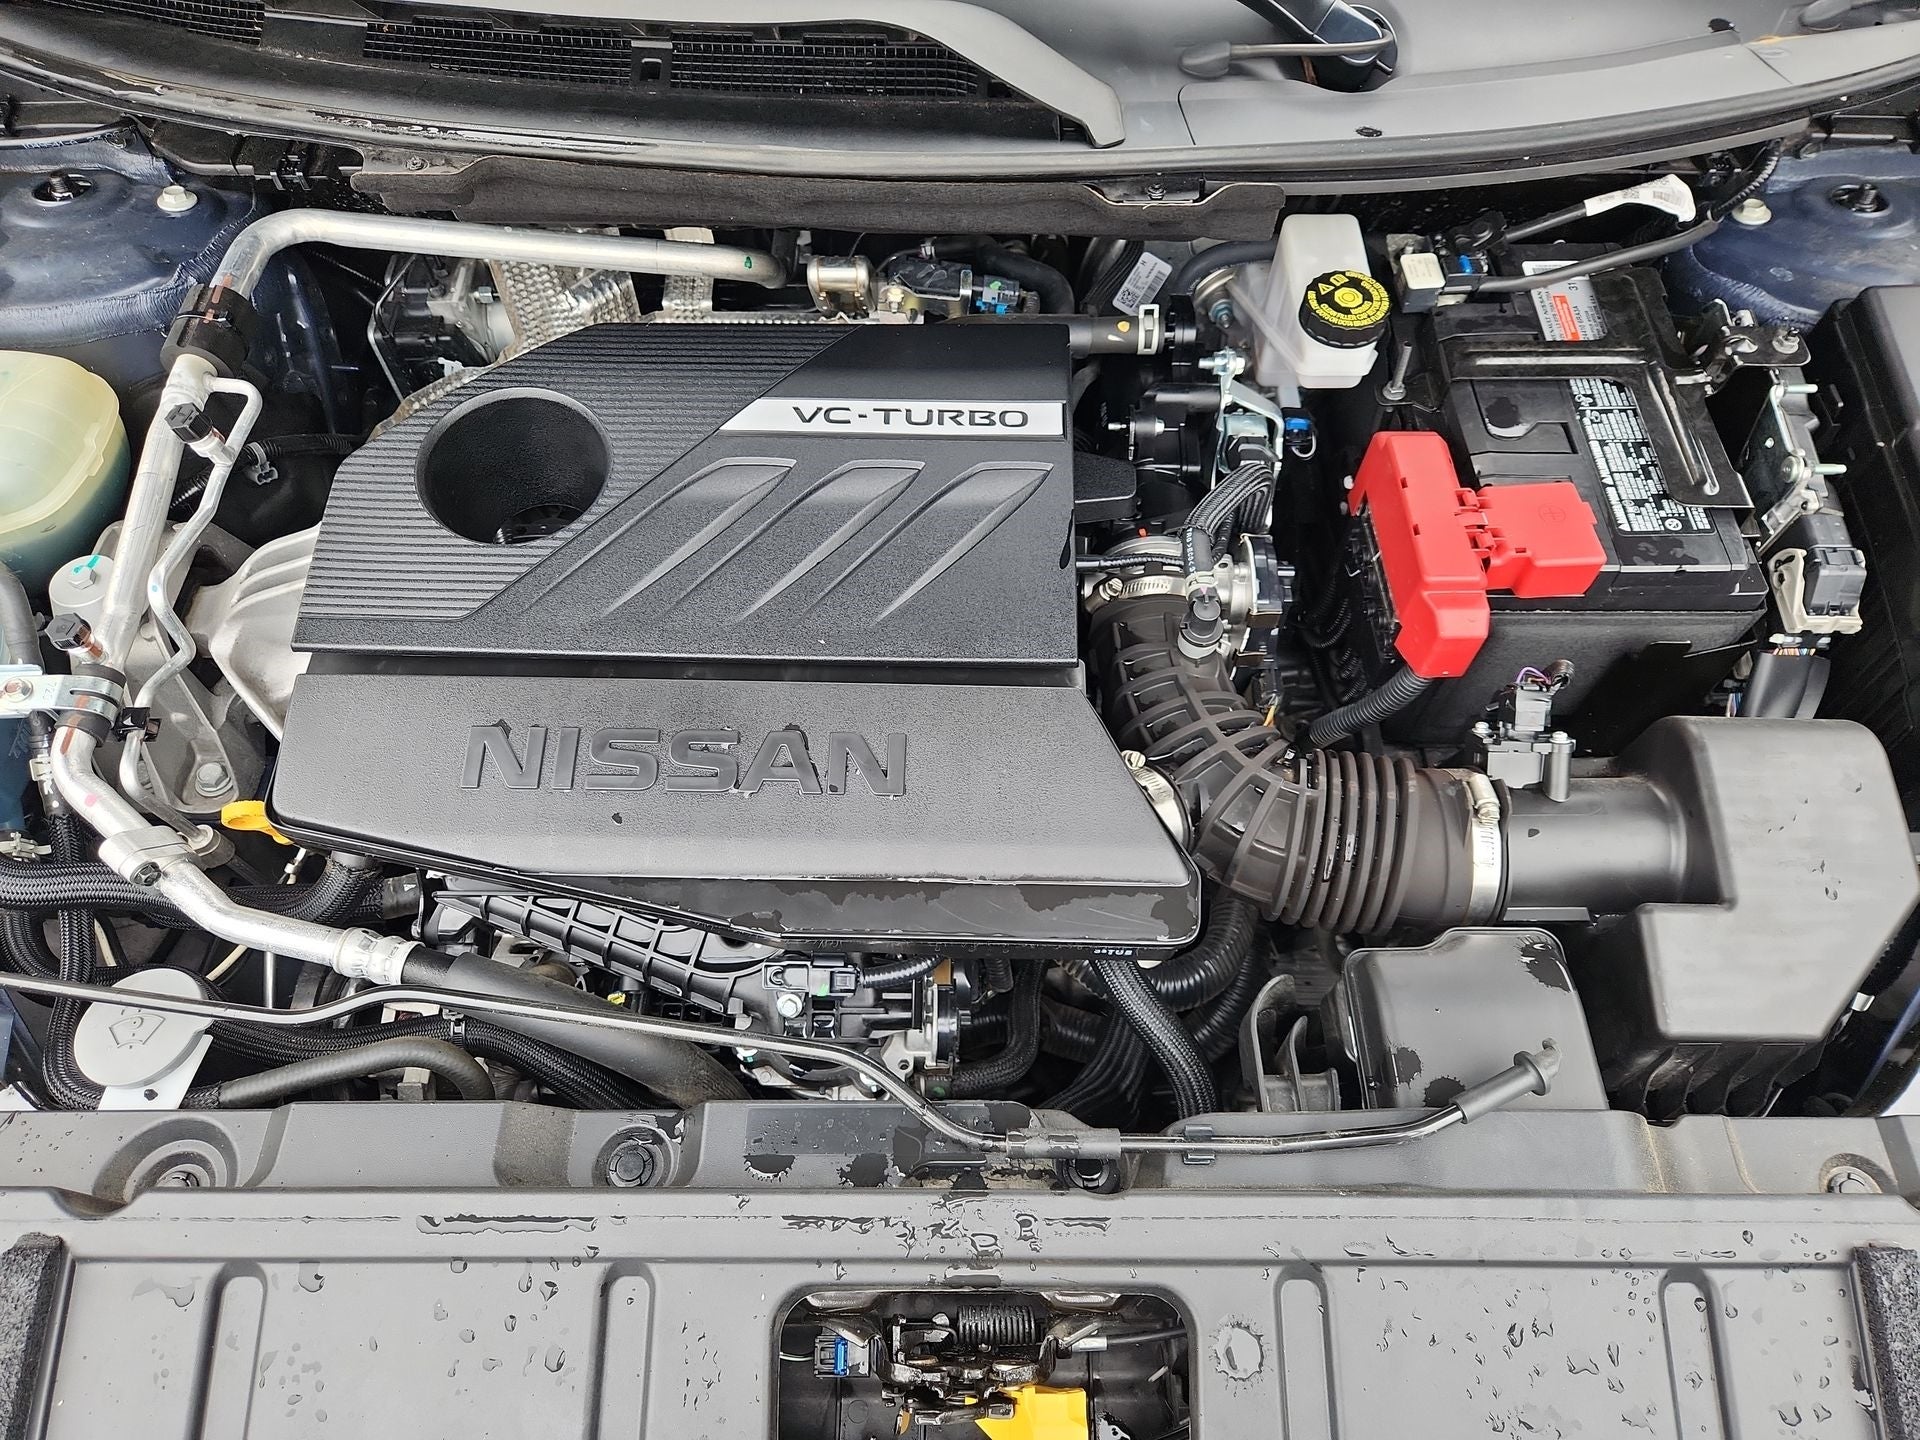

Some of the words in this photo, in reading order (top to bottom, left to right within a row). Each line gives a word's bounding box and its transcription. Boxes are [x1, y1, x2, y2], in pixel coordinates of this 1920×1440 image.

[1567, 282, 1578, 291] 31
[792, 406, 1029, 428] VC-TURBO
[460, 724, 907, 797] NISSAN
